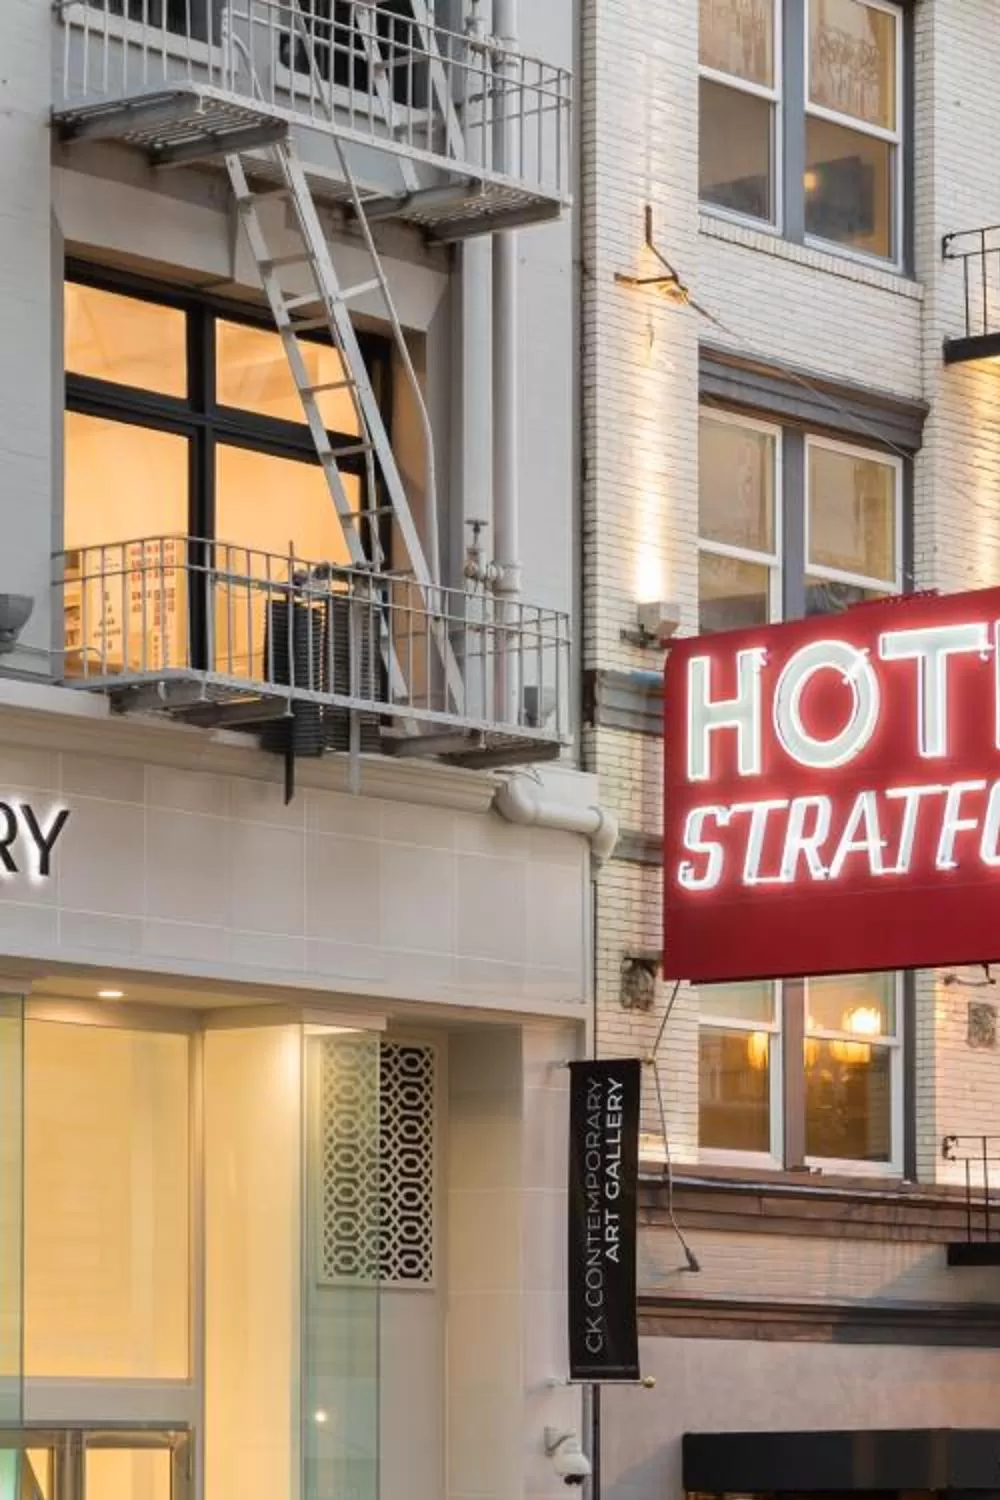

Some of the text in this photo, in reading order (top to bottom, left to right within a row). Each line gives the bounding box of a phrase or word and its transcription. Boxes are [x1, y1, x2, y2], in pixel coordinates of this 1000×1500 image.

[585, 1076, 603, 1353] CK CONTEMPORARY
[605, 1076, 624, 1263] ART GALLERY
